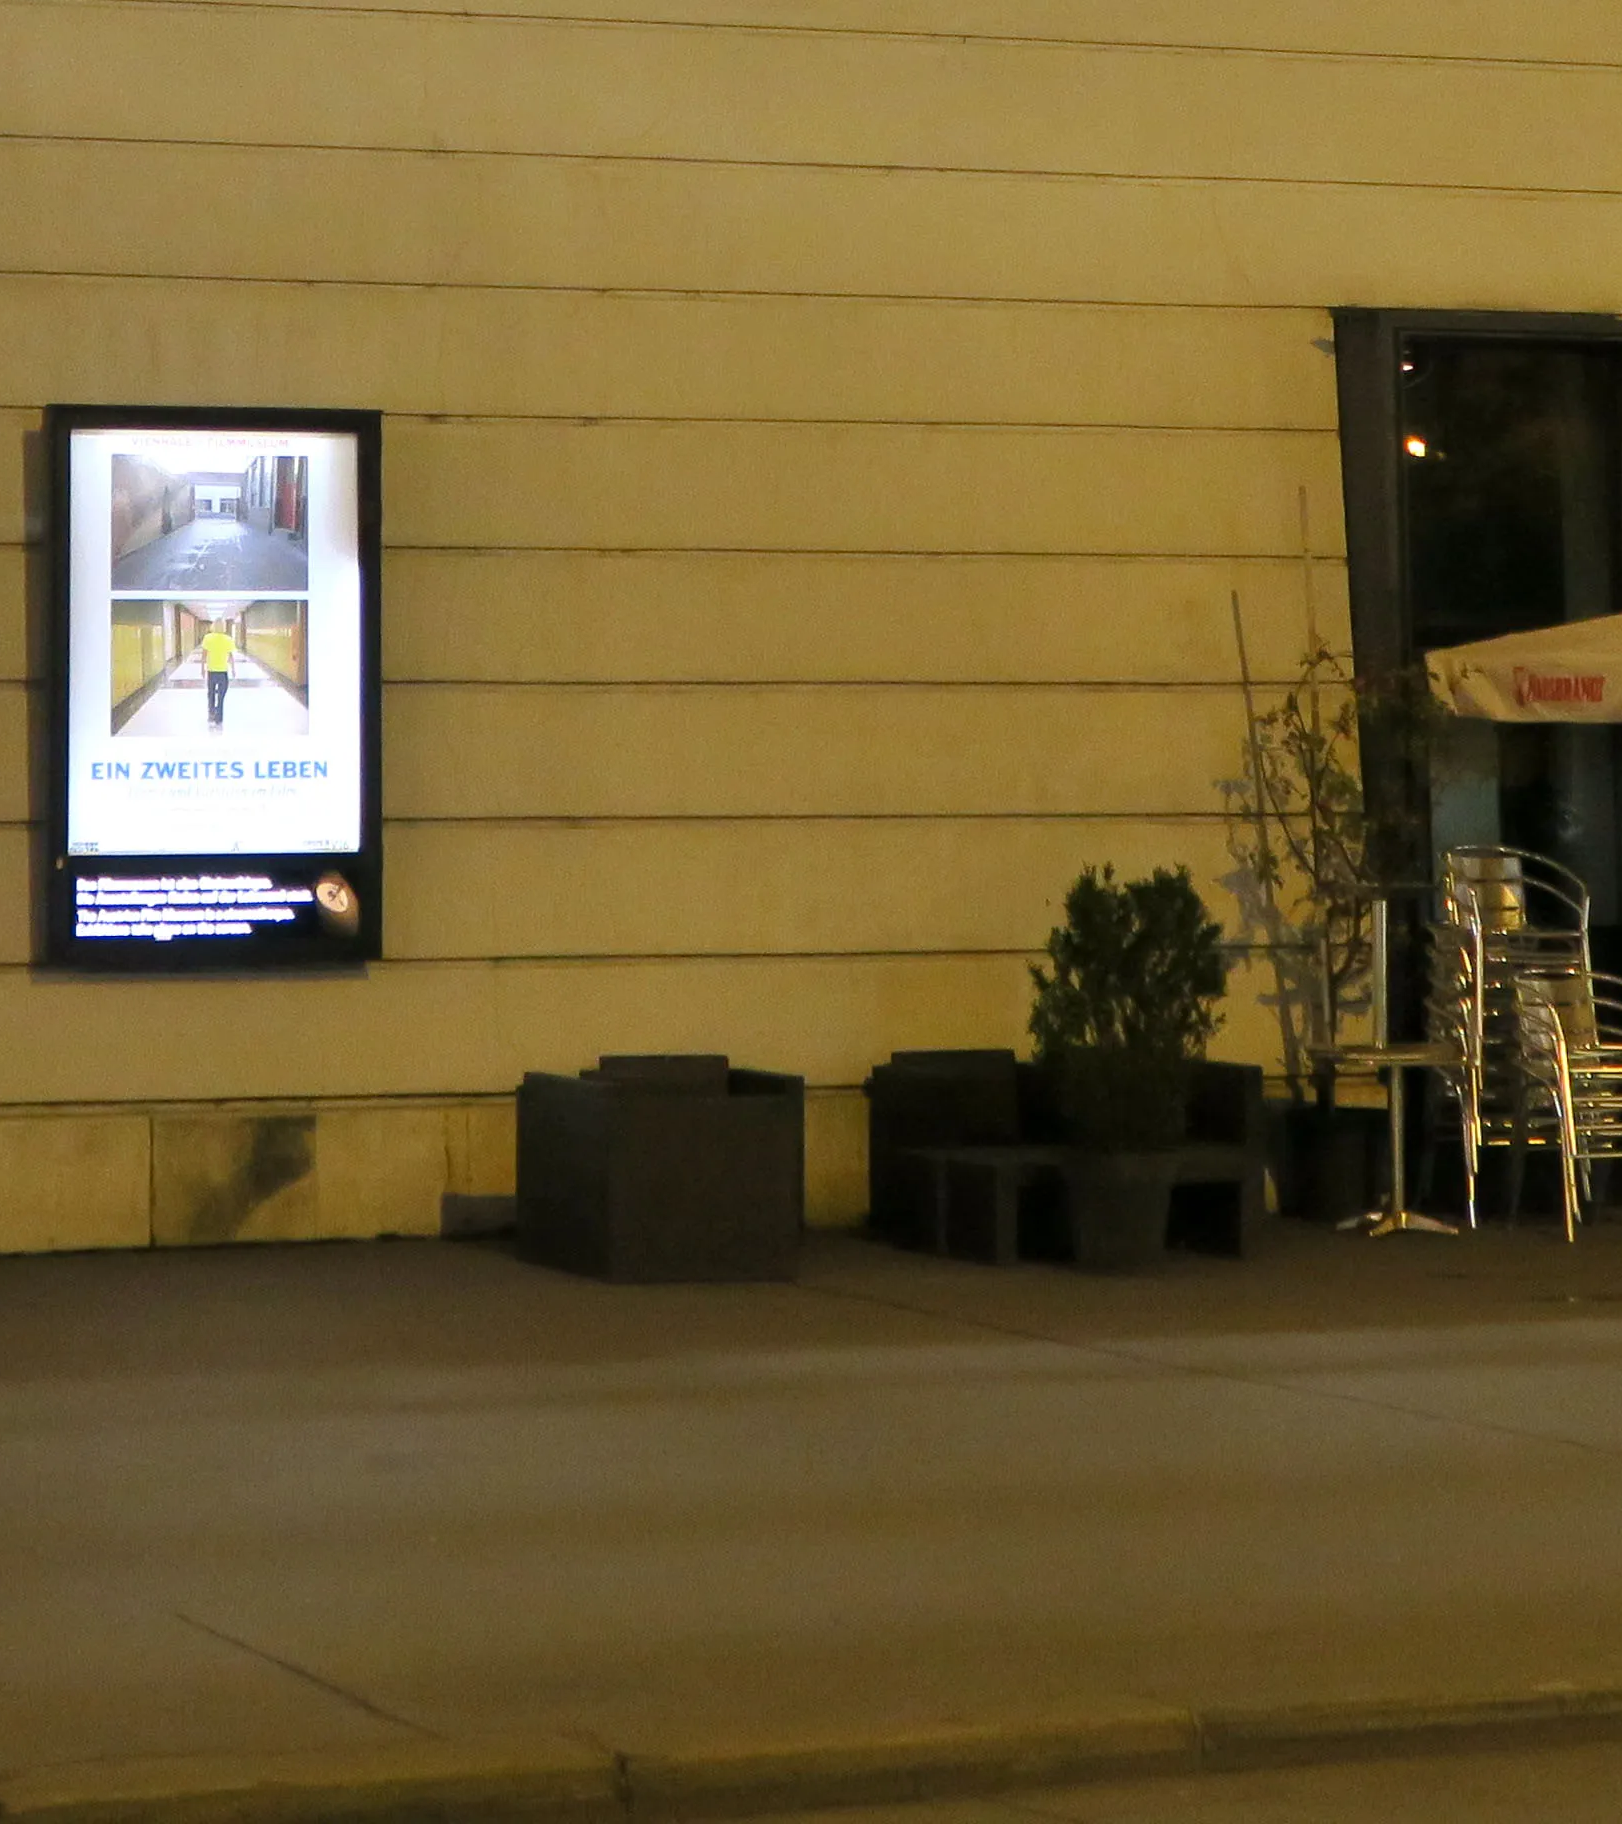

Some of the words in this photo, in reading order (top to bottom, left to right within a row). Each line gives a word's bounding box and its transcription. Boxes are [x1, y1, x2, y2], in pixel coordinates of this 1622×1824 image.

[91, 761, 130, 780] EIN
[141, 760, 245, 780] ZWEITES
[254, 760, 329, 780] LEBEN
